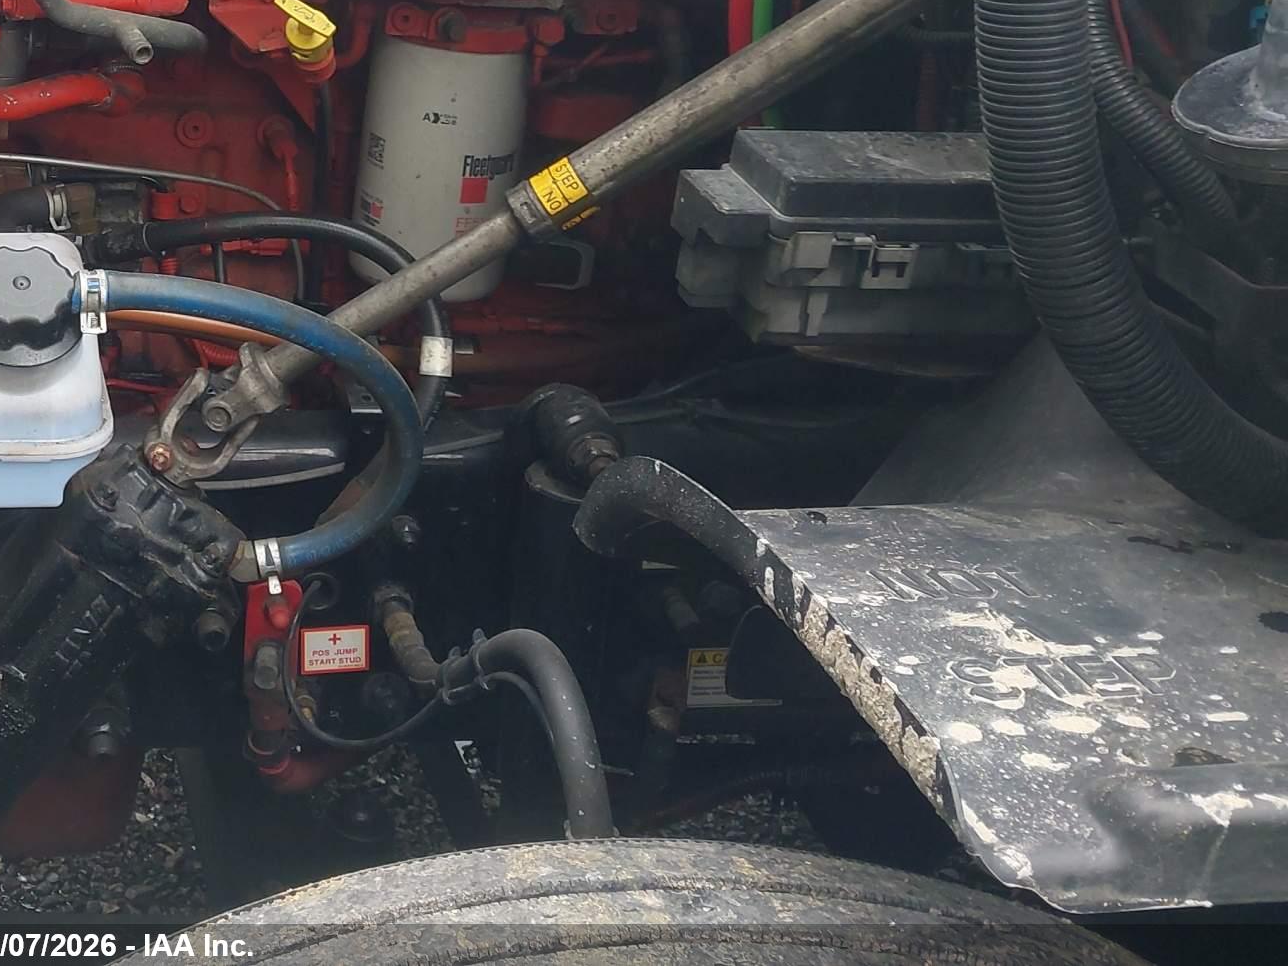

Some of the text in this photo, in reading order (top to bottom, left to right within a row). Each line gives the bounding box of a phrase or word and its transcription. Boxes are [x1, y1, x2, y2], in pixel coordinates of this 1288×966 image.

[555, 163, 580, 192] STEP
[543, 190, 562, 212] NO
[308, 658, 336, 667] START
[338, 656, 362, 665] STUD
[312, 647, 358, 657] POS JUMP
[946, 654, 1178, 710] STEP
